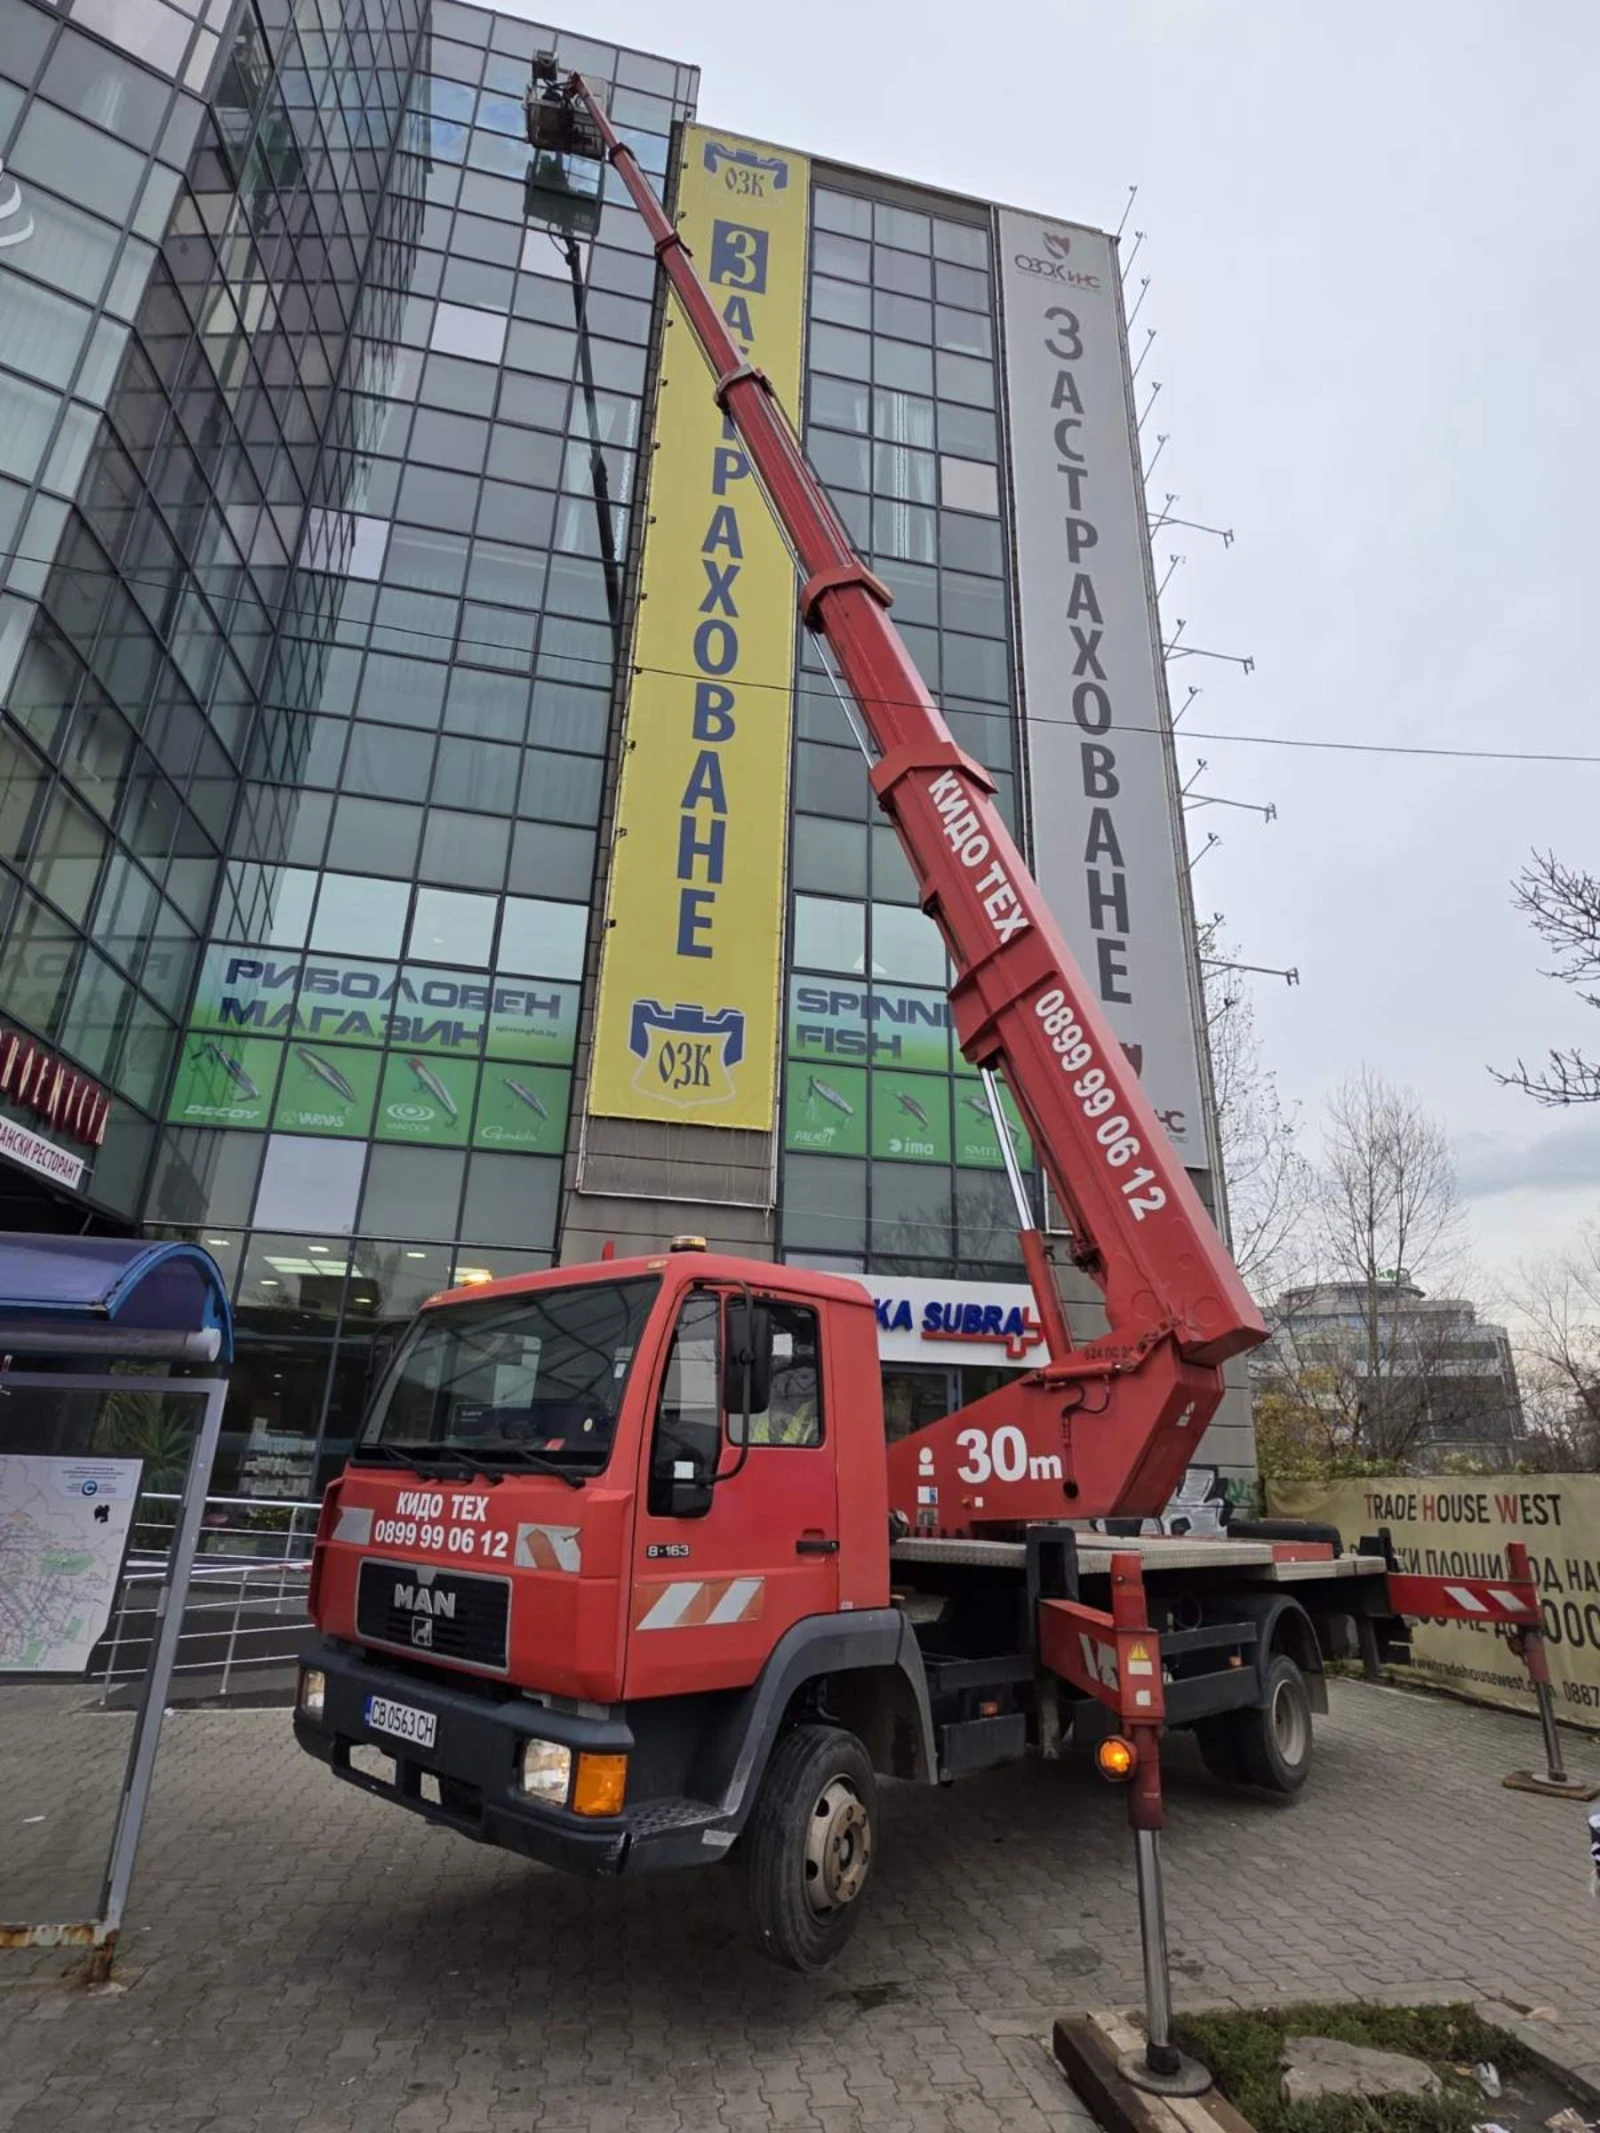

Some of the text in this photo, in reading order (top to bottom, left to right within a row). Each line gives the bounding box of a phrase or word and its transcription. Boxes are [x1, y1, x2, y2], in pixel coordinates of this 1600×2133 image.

[677, 230, 757, 959] ЗАРАХОВАНЕ
[1044, 307, 1132, 1004] ЗАСТРАХОВАНЕ
[928, 769, 1031, 943] КИДО ТЕХ
[225, 957, 562, 1021] РИБОЛОВЕН
[218, 997, 487, 1048] МАГАЗИН
[796, 1023, 903, 1059] FISH
[658, 1039, 712, 1090] ОЗК
[1035, 989, 1167, 1222] 0899 99 06 12
[30, 1143, 80, 1182] РЕСТОРАНТ
[921, 1301, 1025, 1337] SUBRA
[956, 1425, 1064, 1484] 30m
[396, 1491, 490, 1523] КИДО ТЕХ
[1364, 1493, 1562, 1526] TRADE HOUSE WEST
[375, 1519, 509, 1558] 0899 99 06 12
[1425, 1548, 1504, 1580] ПЛОЩИ
[394, 1583, 456, 1619] MAN
[387, 1705, 415, 1736] 0563
